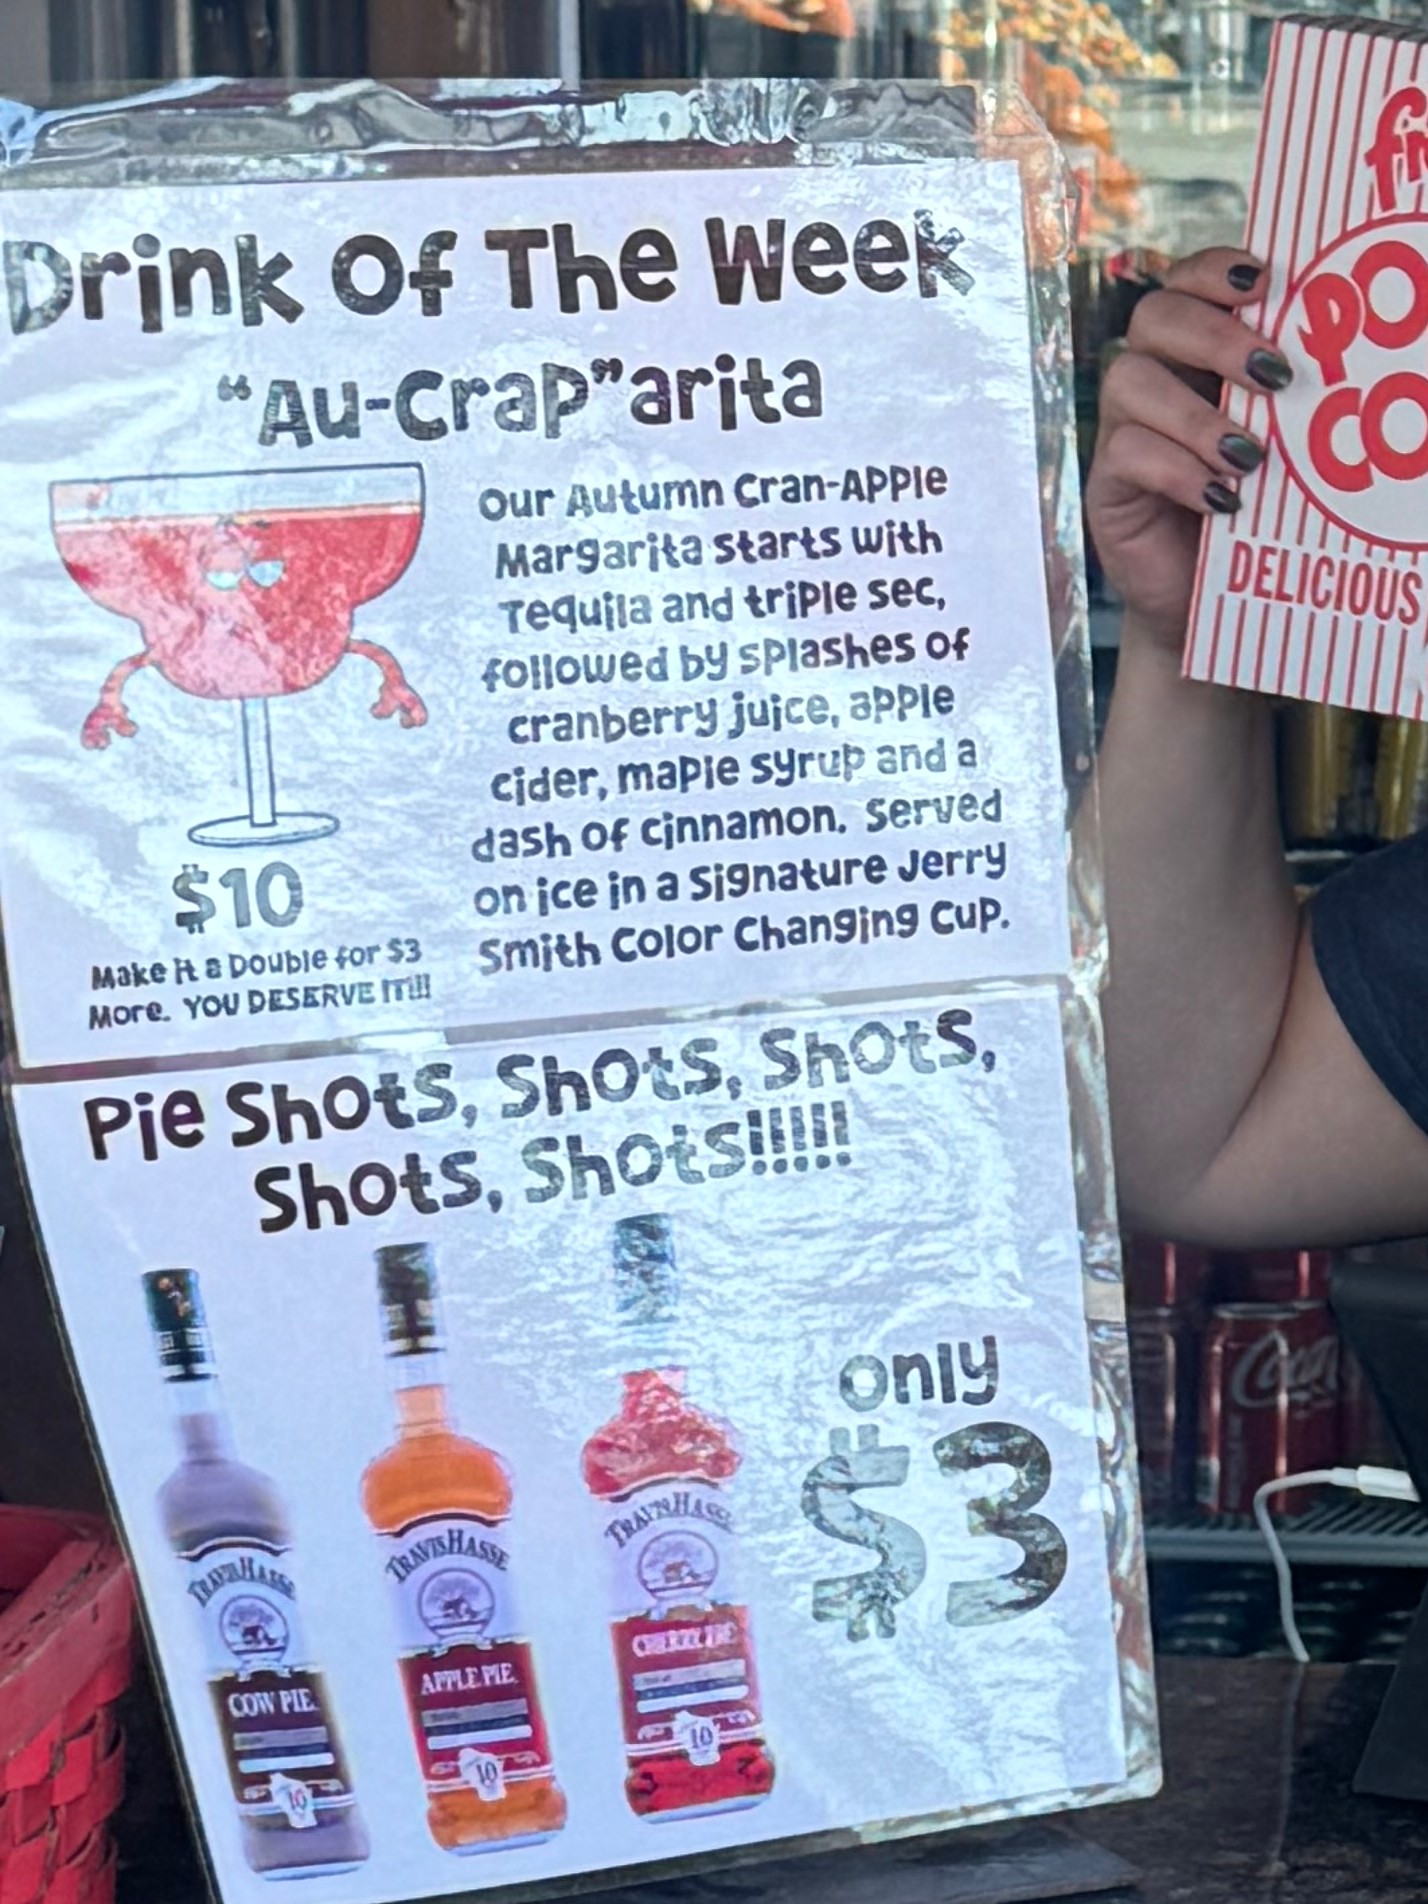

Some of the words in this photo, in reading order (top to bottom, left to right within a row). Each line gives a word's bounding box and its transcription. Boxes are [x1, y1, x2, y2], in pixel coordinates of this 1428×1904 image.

[2, 231, 305, 335] Drink
[331, 229, 457, 317] Of
[484, 221, 679, 314] The
[705, 208, 975, 306] Week
[477, 487, 556, 522] Our
[565, 479, 724, 518] Autumn
[733, 464, 948, 508] Cran-Apple
[494, 532, 703, 579] Margarita
[713, 525, 842, 565] starts
[852, 518, 943, 558] with
[1228, 539, 1424, 625] DELICIOUS
[501, 590, 653, 634] Tequila
[662, 586, 734, 623] and
[743, 579, 858, 619] triple
[867, 576, 947, 611] sec,
[481, 645, 669, 692] followed
[679, 641, 728, 682] by
[738, 630, 916, 676] splashes
[925, 626, 971, 661] of
[507, 696, 718, 746] cranberry
[726, 689, 841, 740] juice,
[848, 682, 956, 725] apple
[490, 766, 609, 807] cider,
[617, 755, 741, 795] maple
[750, 742, 866, 788] syrup
[876, 738, 946, 775] and
[956, 737, 978, 769] a
[470, 822, 572, 864] dash
[580, 817, 630, 853] of
[640, 803, 848, 851] cinnamon.
[865, 788, 1003, 834] Served
[172, 861, 304, 935] $10
[473, 881, 527, 918] on
[535, 876, 598, 917] ice
[608, 870, 646, 911] in
[656, 868, 679, 903] a
[689, 853, 888, 902] Signature
[896, 841, 1008, 884] Jerry
[91, 960, 168, 991] Make
[205, 958, 222, 979] a
[228, 949, 329, 979] Double
[335, 945, 382, 970] for
[386, 937, 423, 965] $3
[479, 930, 601, 977] Smith
[611, 920, 723, 963] Color
[734, 900, 919, 952] Changing
[931, 895, 1011, 936] Cup.
[88, 1003, 171, 1031] More.
[183, 993, 240, 1021] YOU
[248, 983, 375, 1015] DESERVE
[82, 1089, 205, 1164] Pie
[226, 1059, 479, 1149] Shots,
[499, 1037, 743, 1120] Shots,
[761, 1008, 998, 1092] Shots,
[253, 1149, 503, 1234] Shots,
[839, 1335, 999, 1412] only
[800, 1421, 1068, 1643] $3
[228, 1692, 275, 1718] COW
